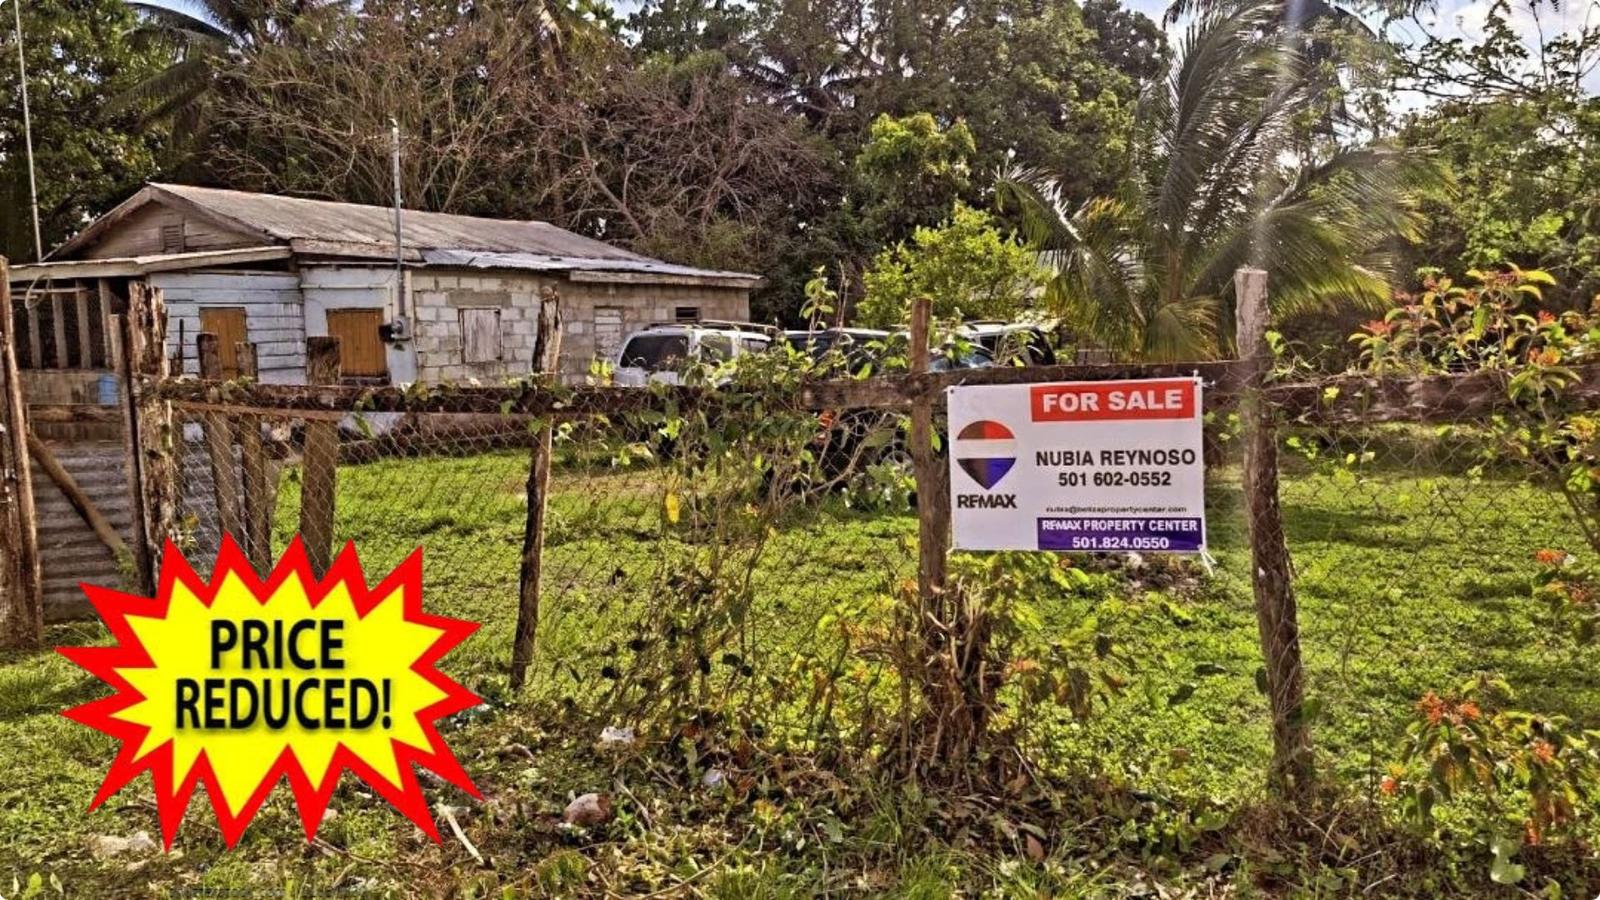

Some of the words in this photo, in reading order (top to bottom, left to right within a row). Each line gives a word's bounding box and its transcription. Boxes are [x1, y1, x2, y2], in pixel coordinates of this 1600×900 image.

[1043, 392, 1099, 413] FOR
[1108, 389, 1184, 410] SALE
[1036, 450, 1094, 466] NUBIA
[1100, 449, 1196, 466] REYNOSO
[1058, 472, 1087, 486] 501
[1093, 471, 1172, 486] 602-0552
[1083, 520, 1145, 532] PROPERTY
[1148, 519, 1198, 532] CENTER
[1072, 535, 1170, 549] 501.824.0550
